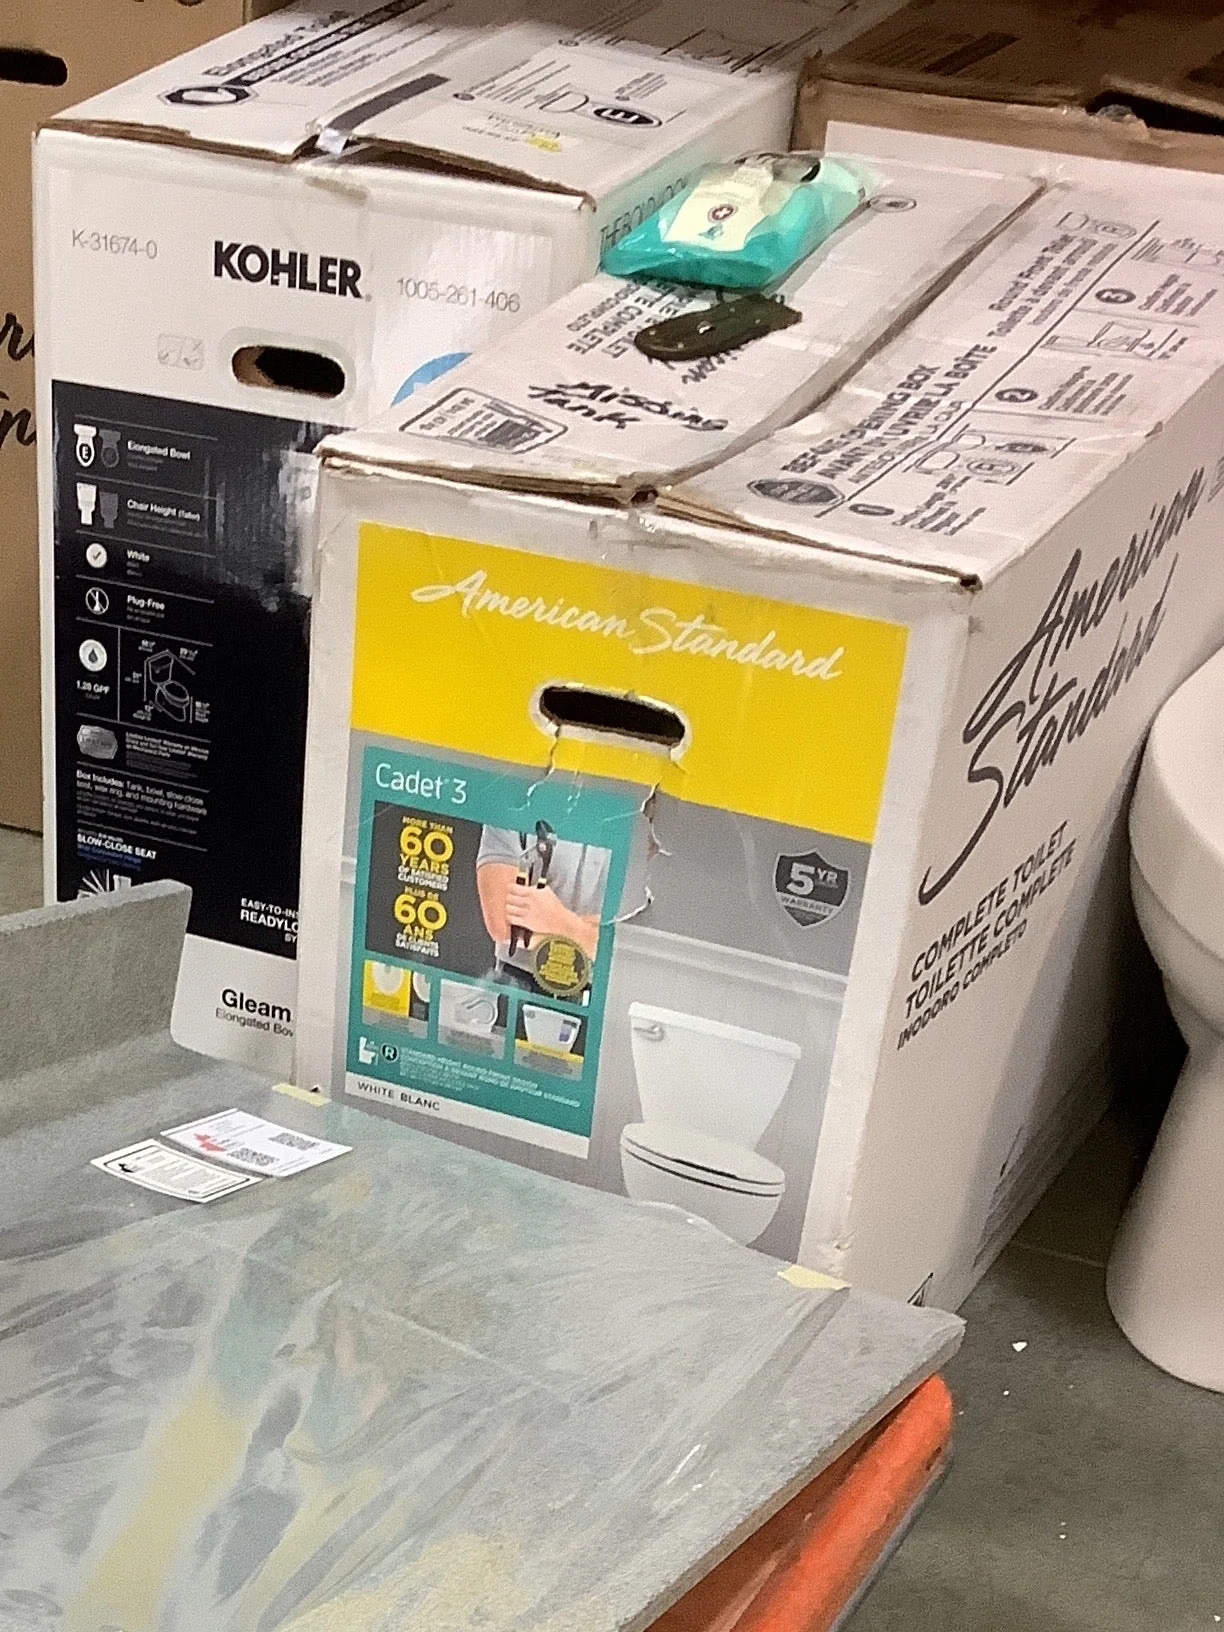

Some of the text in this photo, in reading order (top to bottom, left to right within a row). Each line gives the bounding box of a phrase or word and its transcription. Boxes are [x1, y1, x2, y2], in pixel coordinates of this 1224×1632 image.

[71, 229, 158, 260] K-31674-0
[213, 240, 364, 299] KOHLER
[396, 277, 522, 313] 1005-261-406
[169, 448, 191, 461] Bowl
[150, 503, 177, 518] Height
[127, 549, 151, 563] White
[963, 466, 1208, 746] American
[411, 569, 847, 682] American Standard
[918, 551, 1180, 907] Standard
[375, 763, 468, 804] Cadet 3
[399, 824, 454, 863] 60
[398, 853, 450, 876] YEARS
[786, 862, 838, 896] 5 YR
[397, 872, 449, 893] CUSTOMERS
[394, 893, 447, 931] 60
[911, 820, 1068, 983] COMPLETE TOILET
[240, 909, 299, 932] READYLO
[403, 923, 435, 942] ANS
[897, 919, 1027, 1051] INODORO COMPLETO
[905, 923, 991, 1019] TOILETTE
[215, 1007, 294, 1038] Elongated Bow
[221, 988, 293, 1023] Gleam
[357, 1080, 441, 1111] WHITE BLANC
